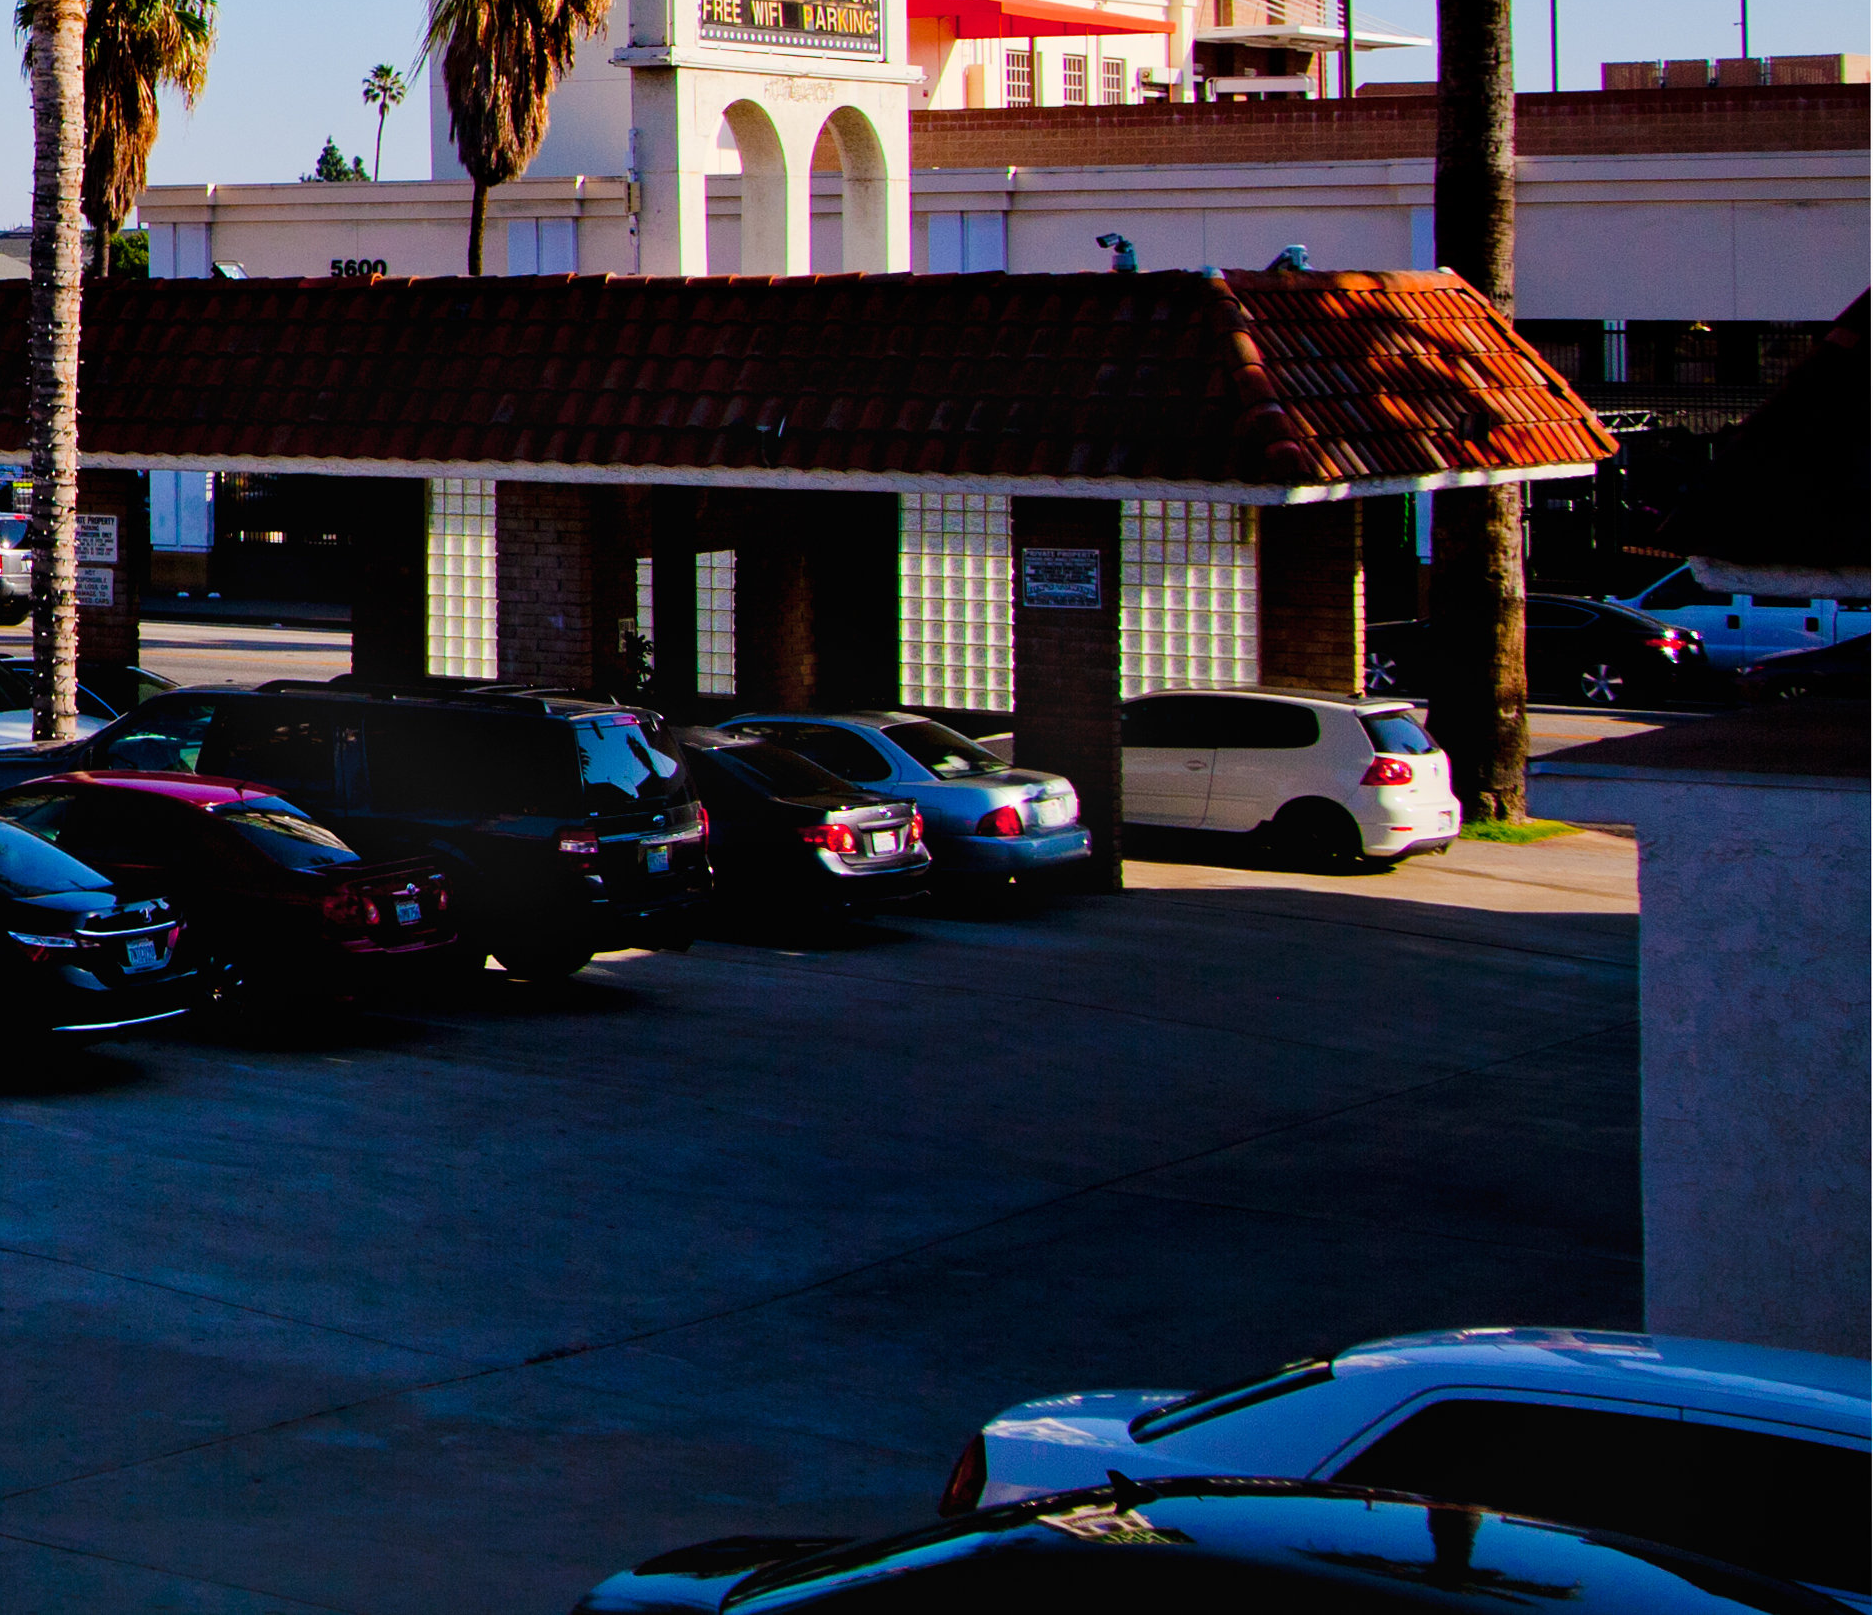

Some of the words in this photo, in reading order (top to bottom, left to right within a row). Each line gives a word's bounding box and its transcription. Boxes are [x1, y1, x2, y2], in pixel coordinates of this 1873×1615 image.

[751, 0, 785, 28] WIFI
[802, 4, 875, 34] PARKING
[330, 258, 388, 276] 5600
